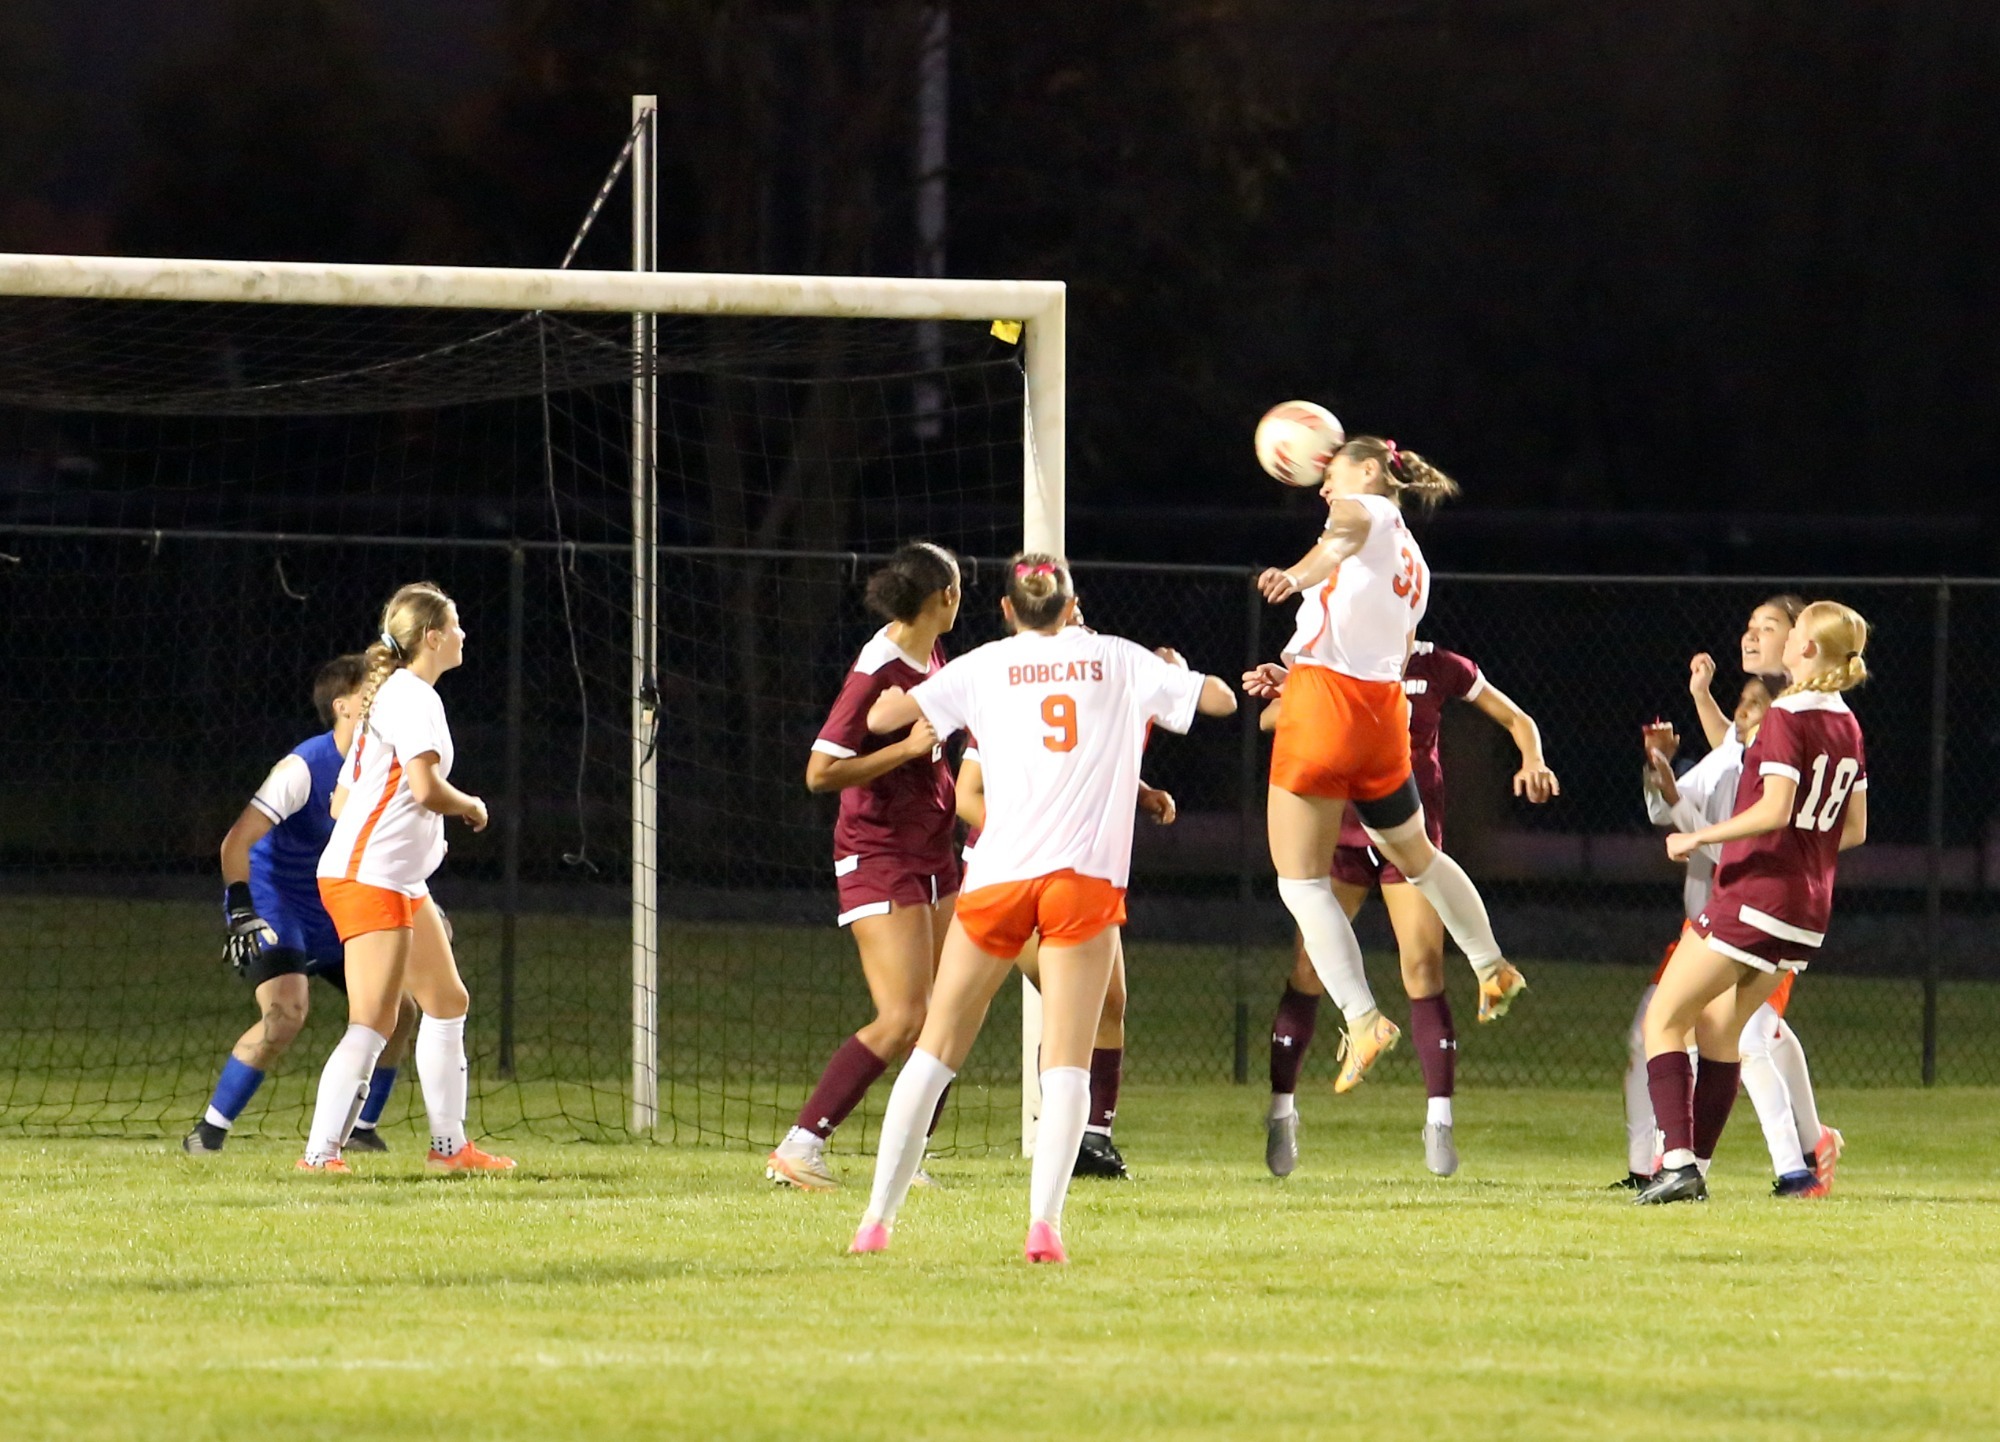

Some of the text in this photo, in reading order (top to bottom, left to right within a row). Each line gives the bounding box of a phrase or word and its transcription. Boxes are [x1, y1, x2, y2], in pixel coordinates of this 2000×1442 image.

[1392, 546, 1422, 610] 31
[1008, 660, 1103, 686] BOBCATS
[1041, 694, 1078, 753] 9
[1795, 753, 1859, 832] 18
